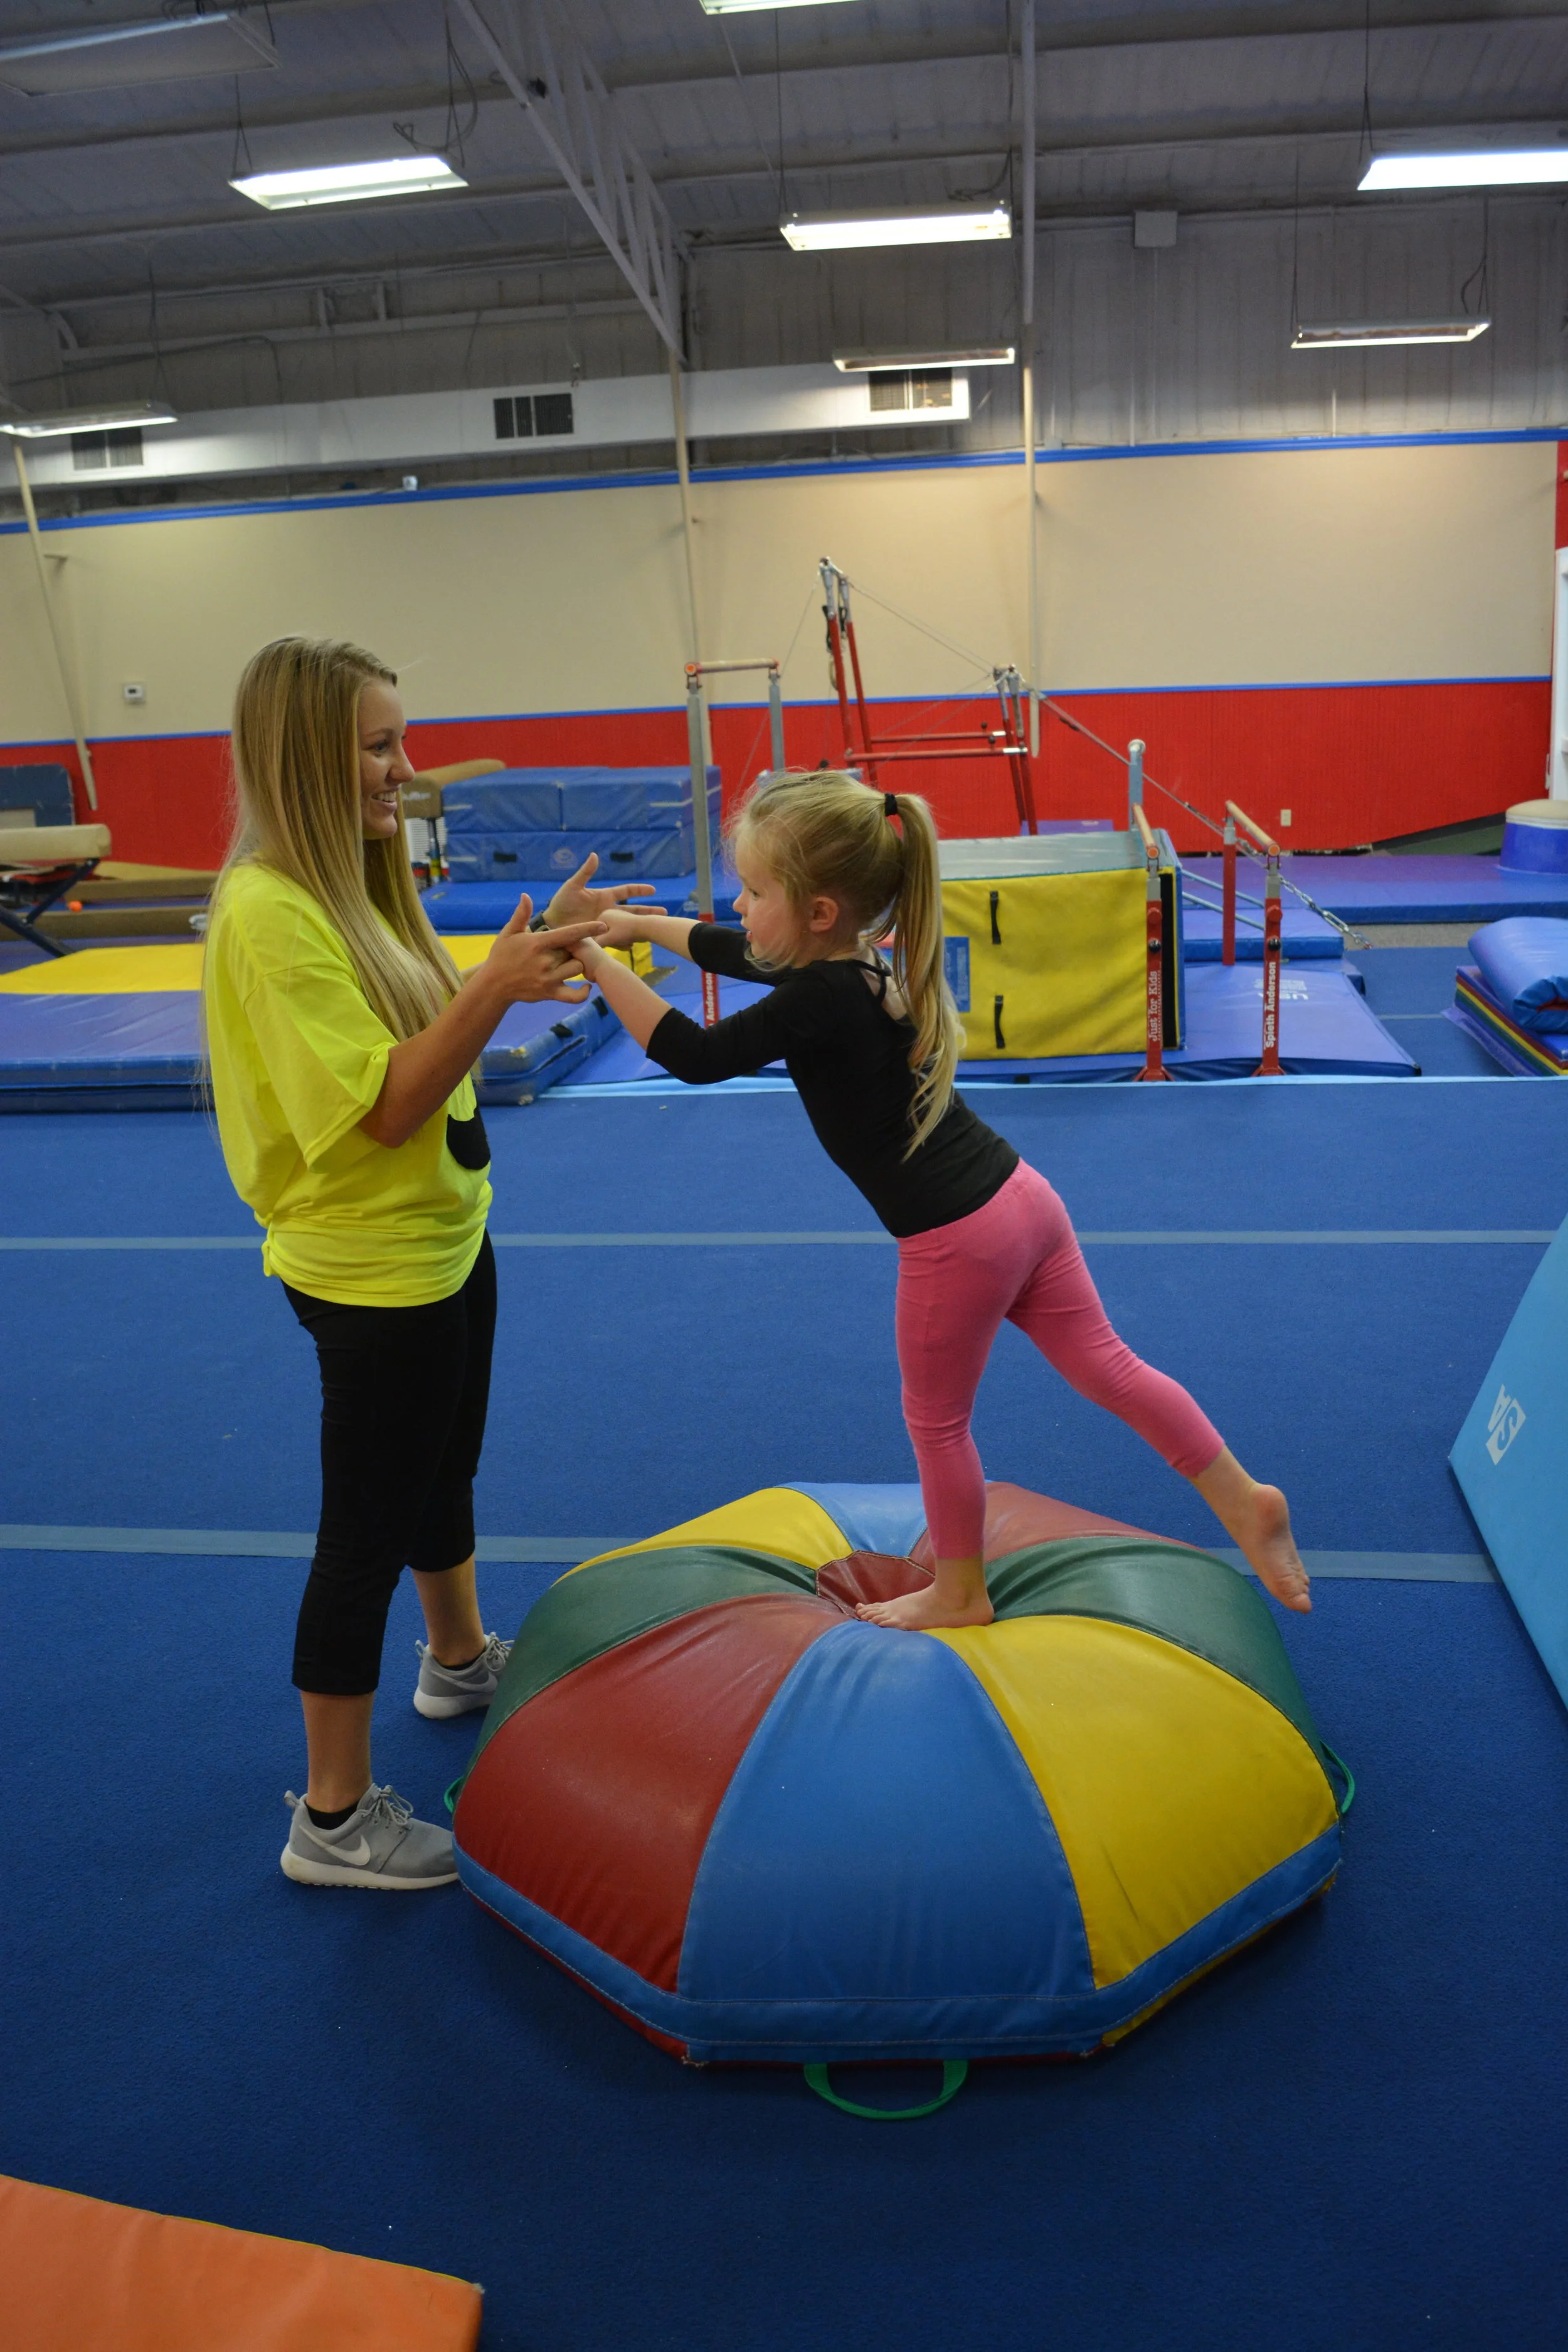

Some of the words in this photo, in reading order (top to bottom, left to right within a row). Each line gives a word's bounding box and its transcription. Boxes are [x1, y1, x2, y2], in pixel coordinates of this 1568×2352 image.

[706, 972, 715, 1021] Anderson
[1148, 970, 1158, 995] Kids
[1266, 962, 1276, 1012] Anderson
[1148, 998, 1158, 1015] for
[1148, 1017, 1158, 1042] Just
[1266, 1014, 1276, 1048] Spieth
